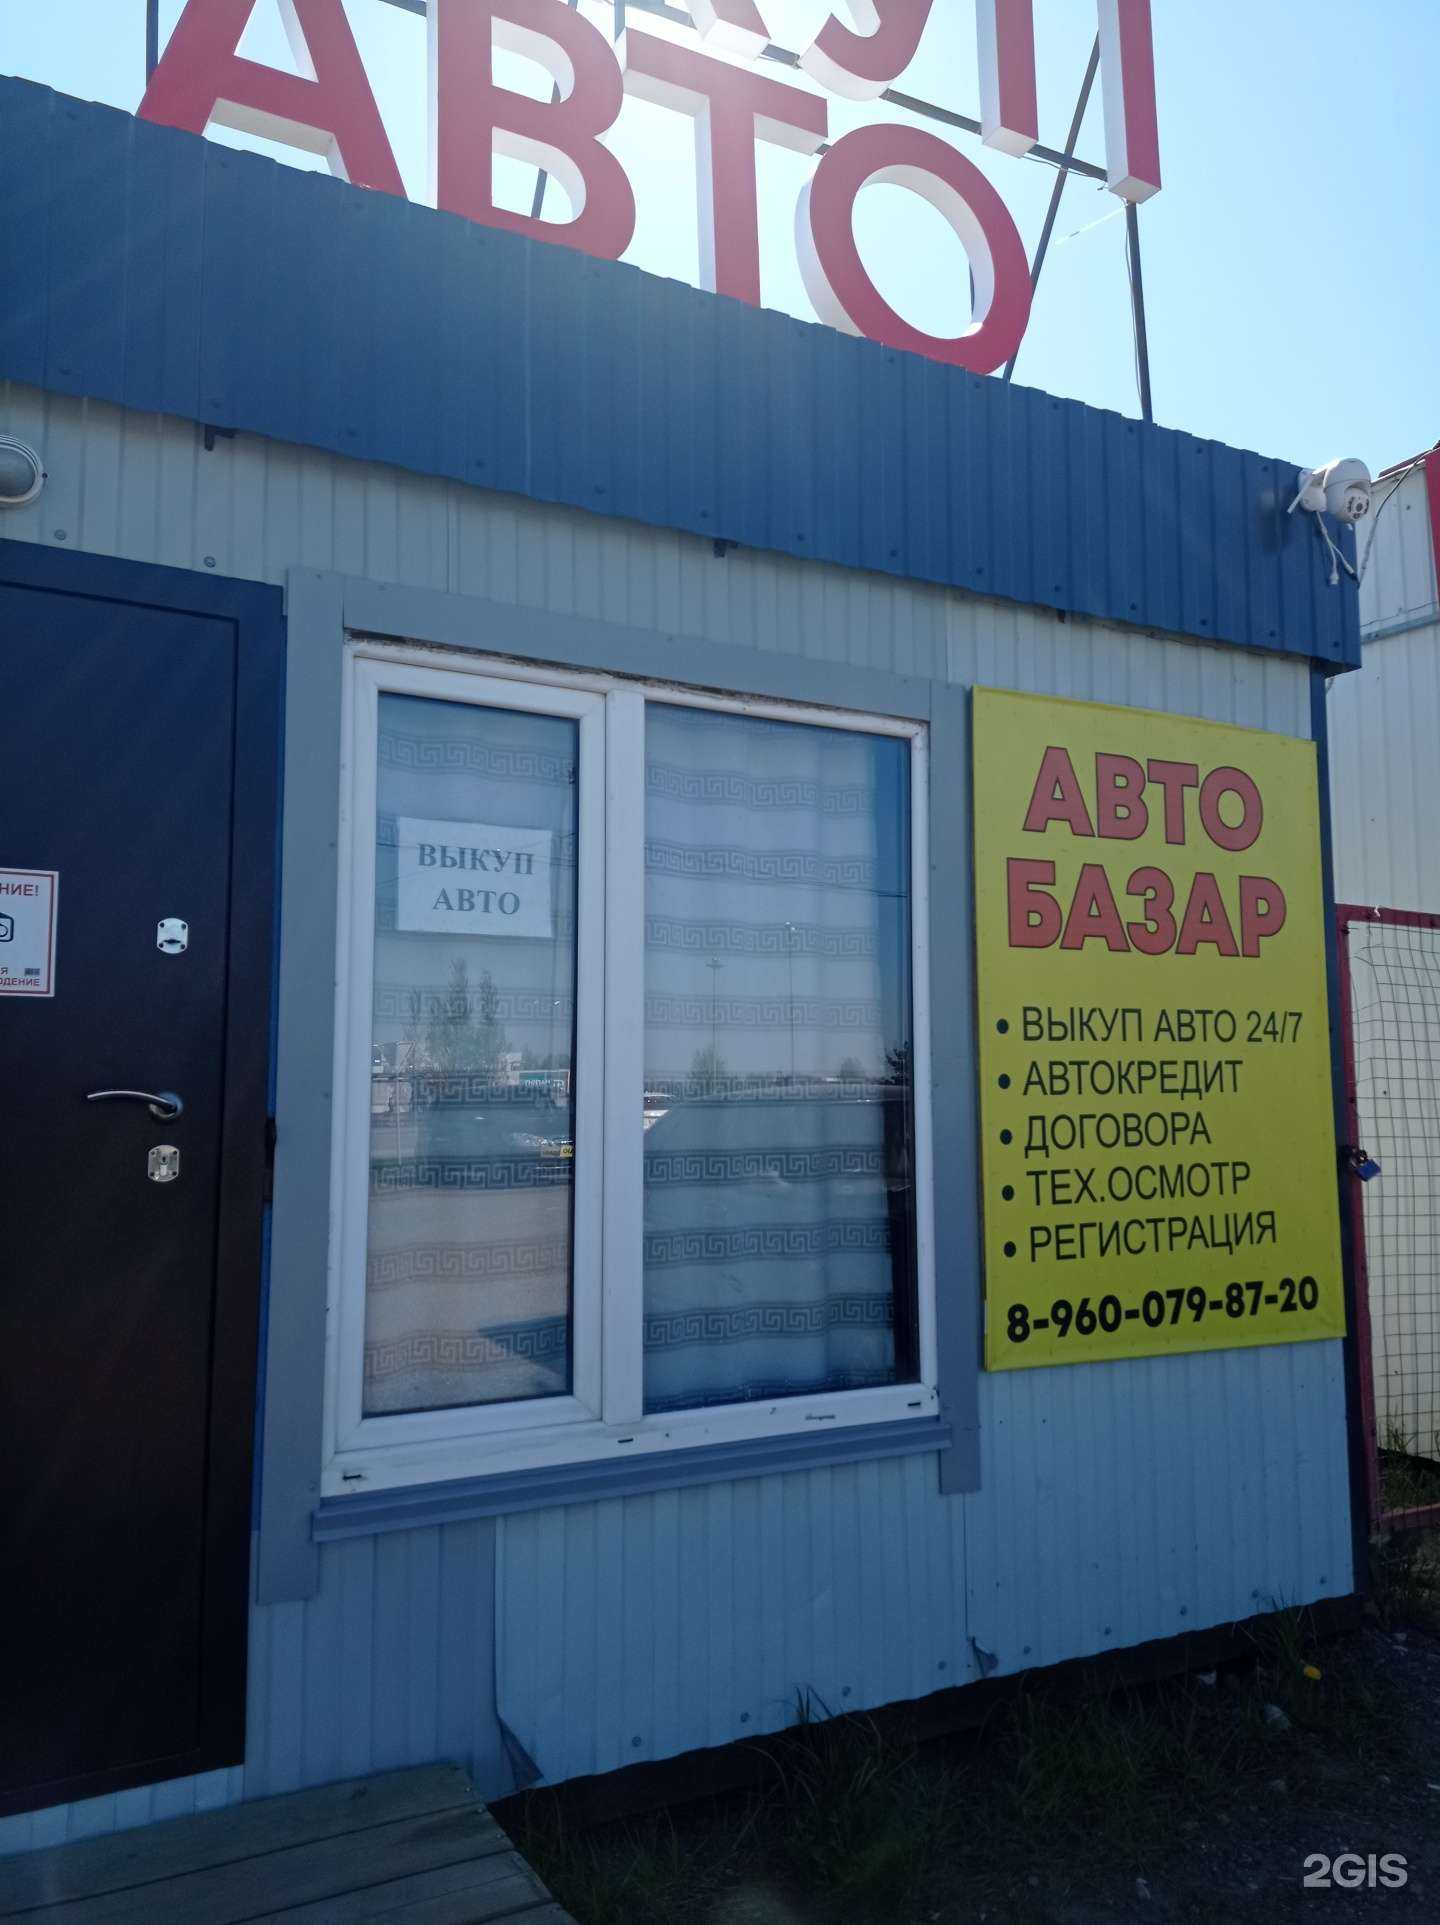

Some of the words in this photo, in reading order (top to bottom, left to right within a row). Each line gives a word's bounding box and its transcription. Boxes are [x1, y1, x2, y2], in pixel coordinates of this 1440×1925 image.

[135, 0, 1032, 376] АВТО
[1022, 745, 1264, 852] АВТО
[417, 843, 535, 875] ВЫКУП
[432, 887, 520, 915] АВТО
[1006, 857, 1287, 958] БАЗАР
[1022, 1006, 1143, 1042] ВЫКУП
[1153, 1008, 1237, 1043] АВТО
[1246, 1010, 1303, 1043] 24/7
[1022, 1060, 1243, 1100] АВТОКРЕДИТ
[1024, 1111, 1212, 1158] ДОГОВОРА
[1026, 1161, 1251, 1206] ТЕХ.ОСМОТР
[1029, 1210, 1277, 1262] РЕГИСТРАЦИЯ
[1007, 1276, 1319, 1343] 8-960-079-87-20
